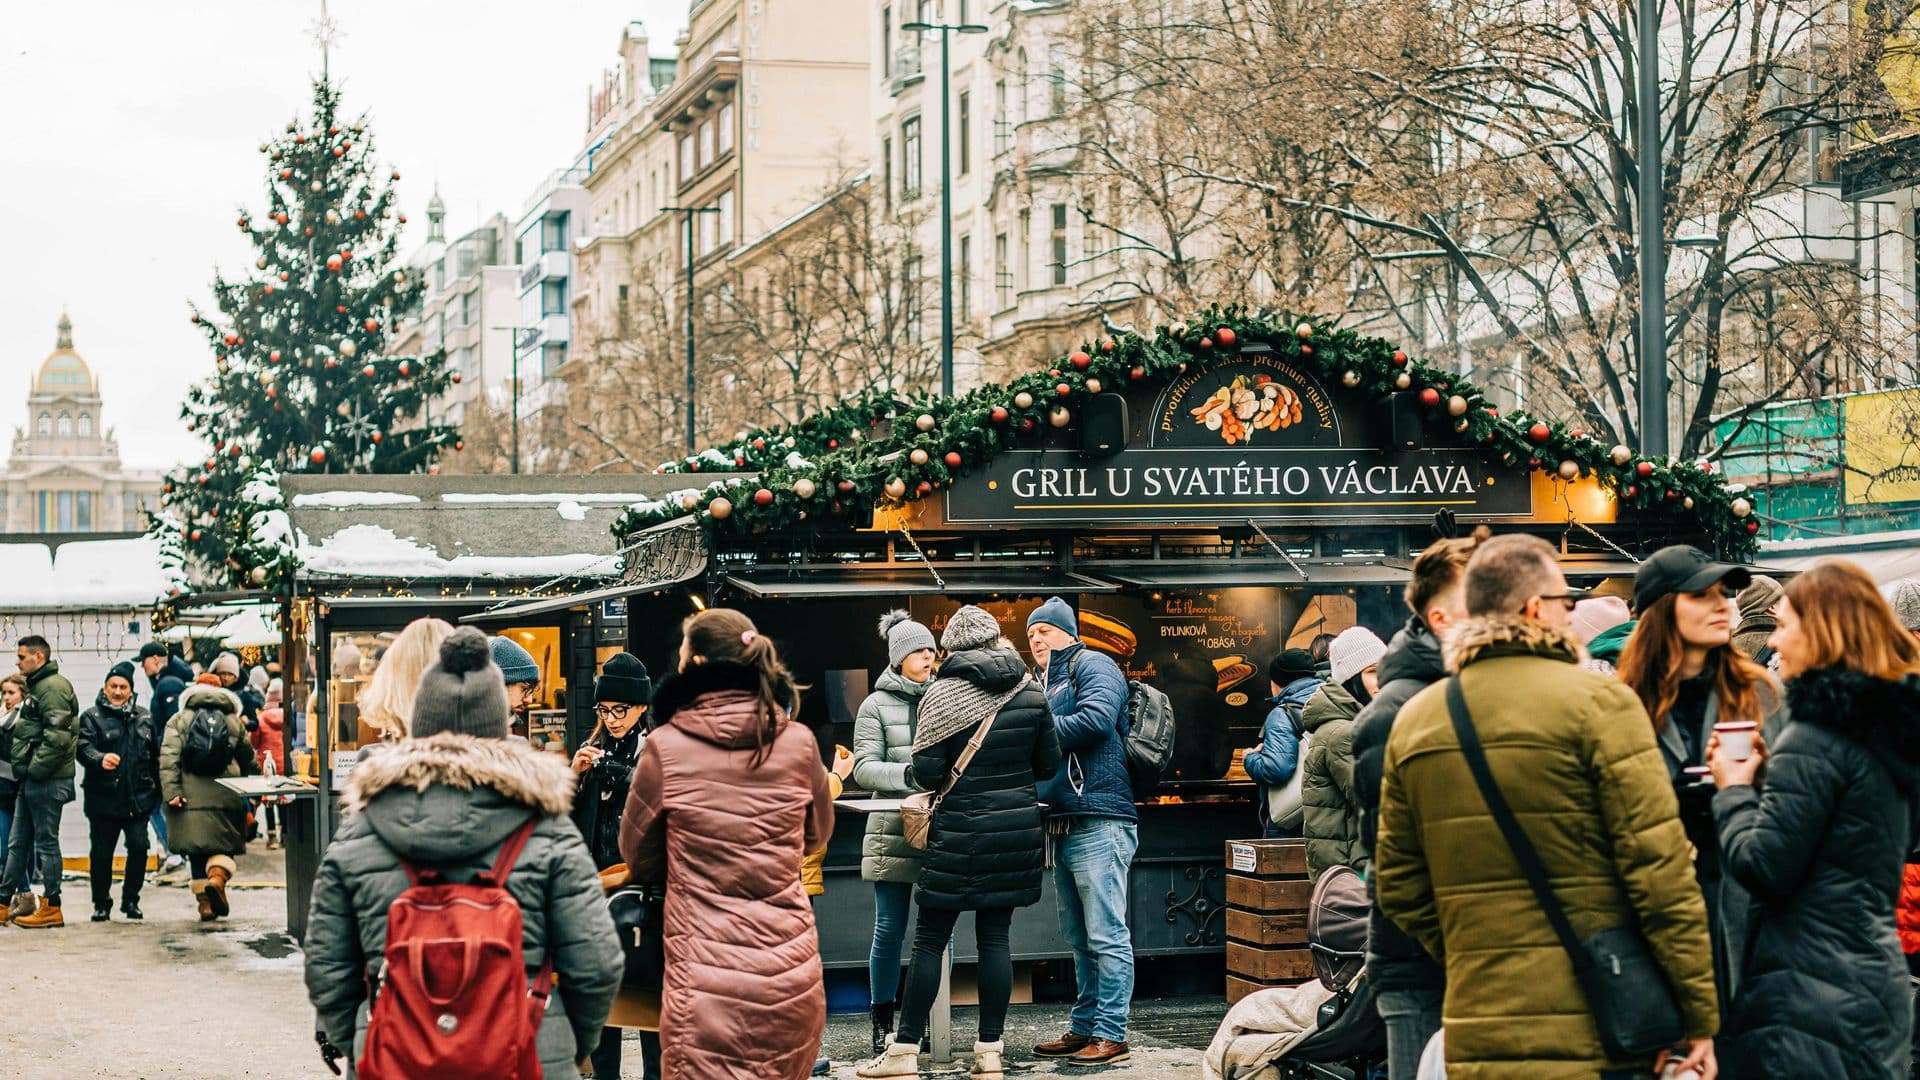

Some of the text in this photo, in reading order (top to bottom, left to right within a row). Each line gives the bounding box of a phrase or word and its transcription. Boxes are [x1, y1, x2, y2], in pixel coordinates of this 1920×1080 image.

[1252, 353, 1333, 429] premium quality
[1011, 459, 1475, 498] GRIL U SVATÉHO VÁCLAVA
[1160, 624, 1208, 637] BYLINKOVÁ
